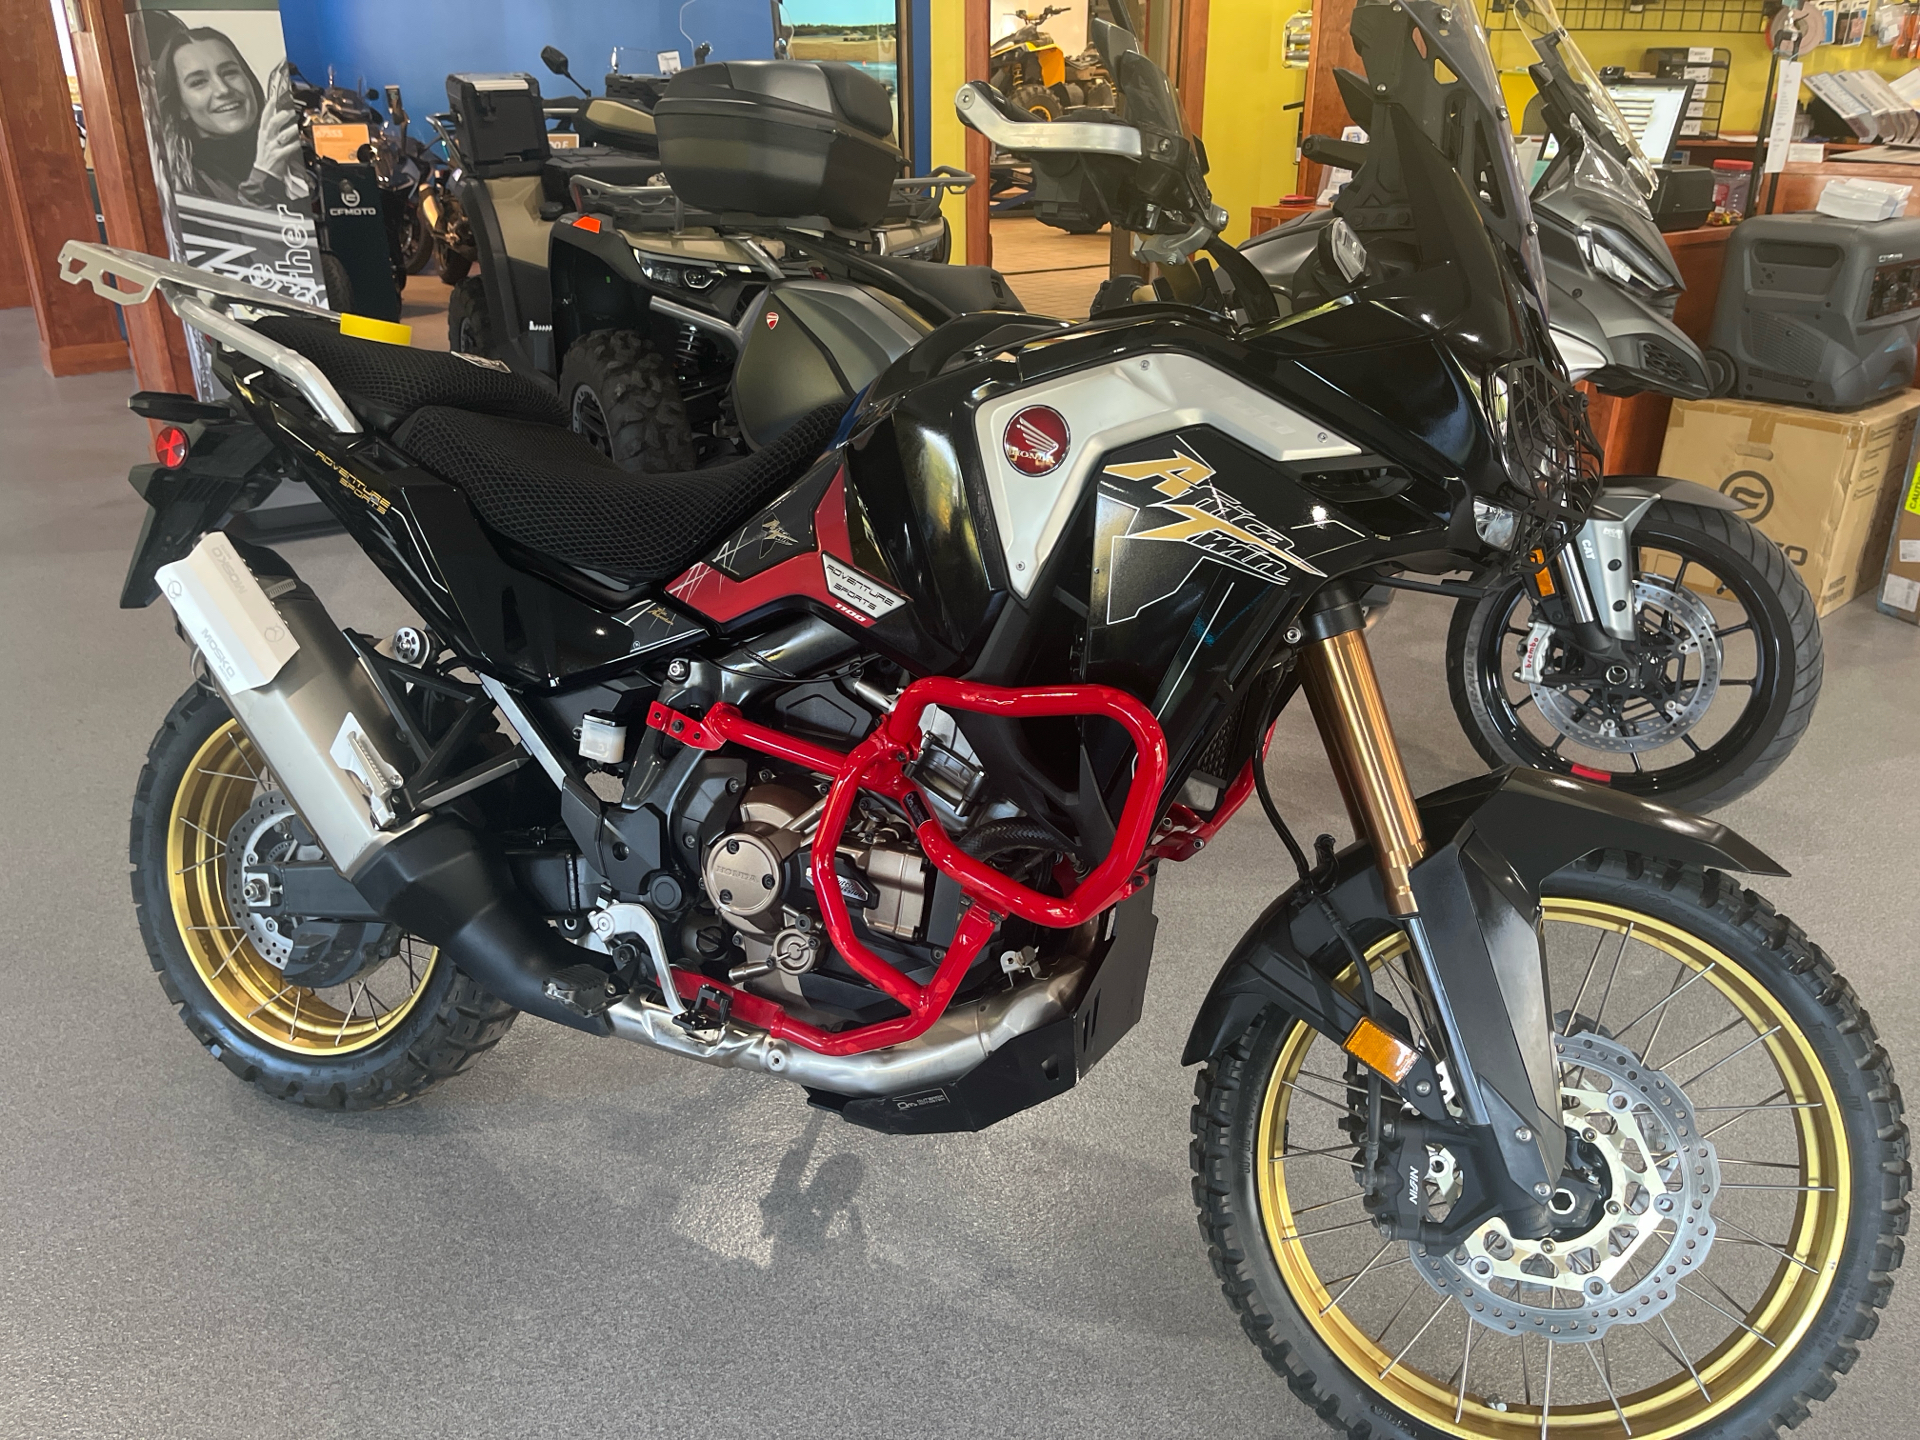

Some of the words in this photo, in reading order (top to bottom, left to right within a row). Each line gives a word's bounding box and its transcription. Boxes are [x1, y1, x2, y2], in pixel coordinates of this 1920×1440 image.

[329, 207, 377, 216] CFMOTO
[1008, 447, 1056, 466] HONDA
[315, 449, 391, 510] ADVENTURE
[339, 477, 387, 515] SPORTS
[210, 546, 248, 595] MOSKO
[826, 564, 895, 607] ADVENTURE
[833, 582, 877, 611] SPORTS
[834, 602, 867, 622] 1100
[200, 627, 236, 678] MOSKO
[1524, 637, 1539, 669] brembo
[715, 865, 759, 883] HONDA
[1409, 1165, 1419, 1205] NISSIN
